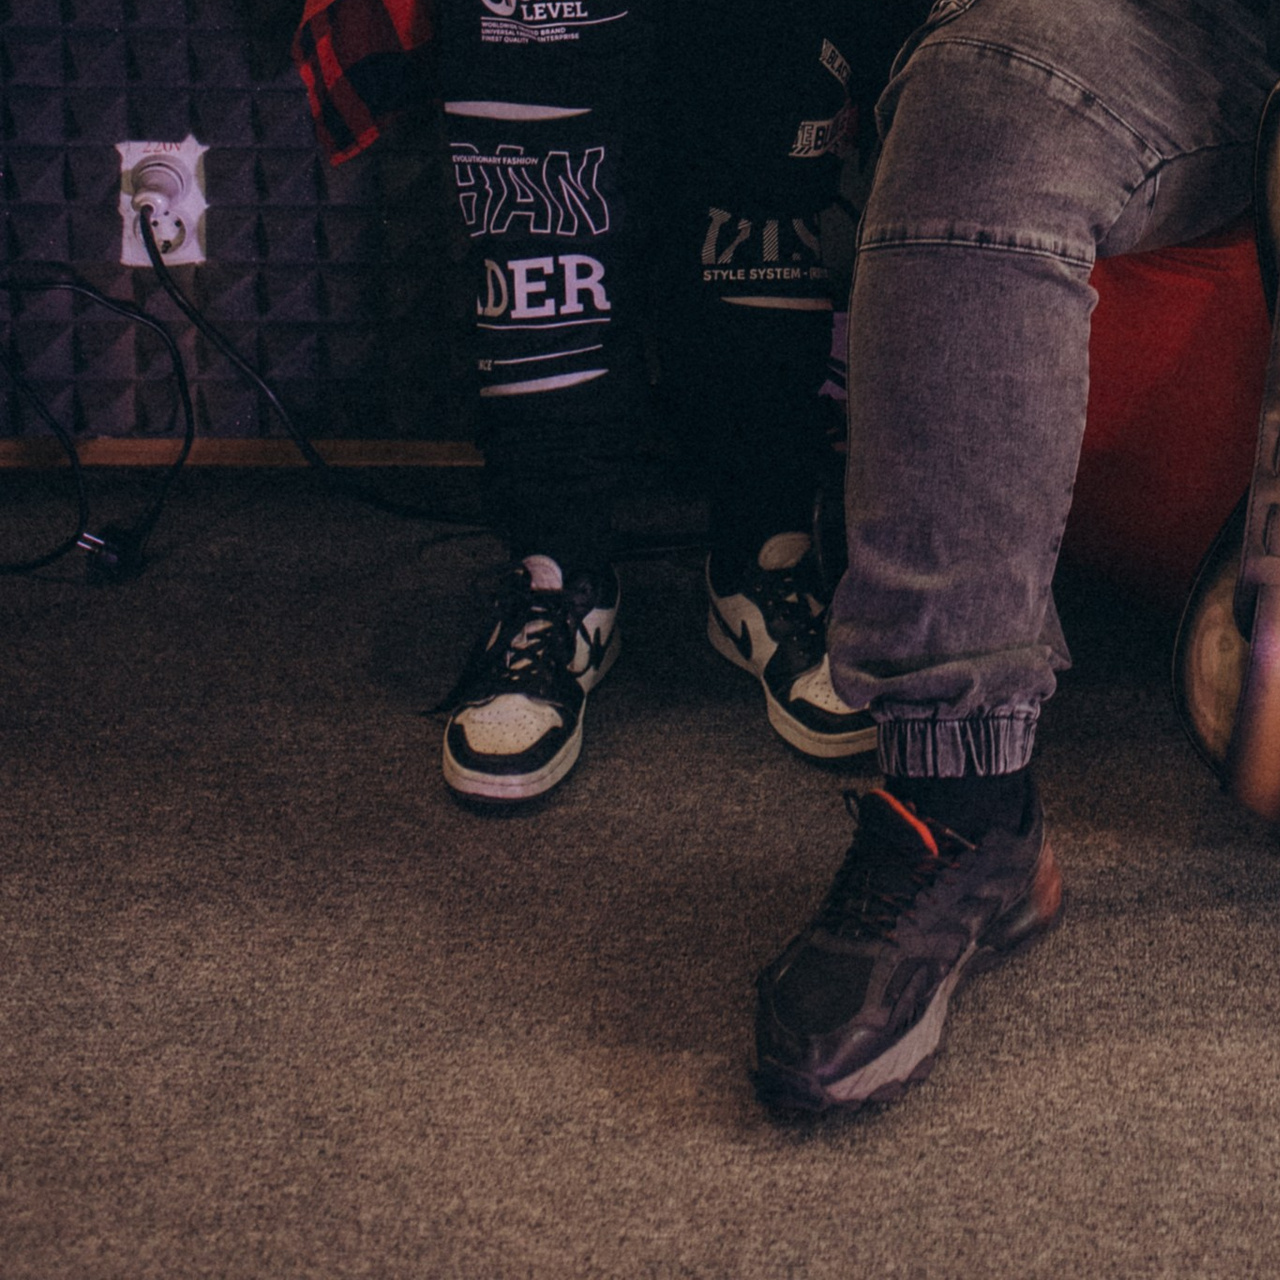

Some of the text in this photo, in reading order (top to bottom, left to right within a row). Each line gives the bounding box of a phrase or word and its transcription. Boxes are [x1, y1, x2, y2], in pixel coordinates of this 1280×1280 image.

[520, 1, 588, 21] LEVEL
[502, 156, 539, 166] FASHION
[702, 268, 746, 282] STYLE
[749, 267, 802, 280] SYSTEM
